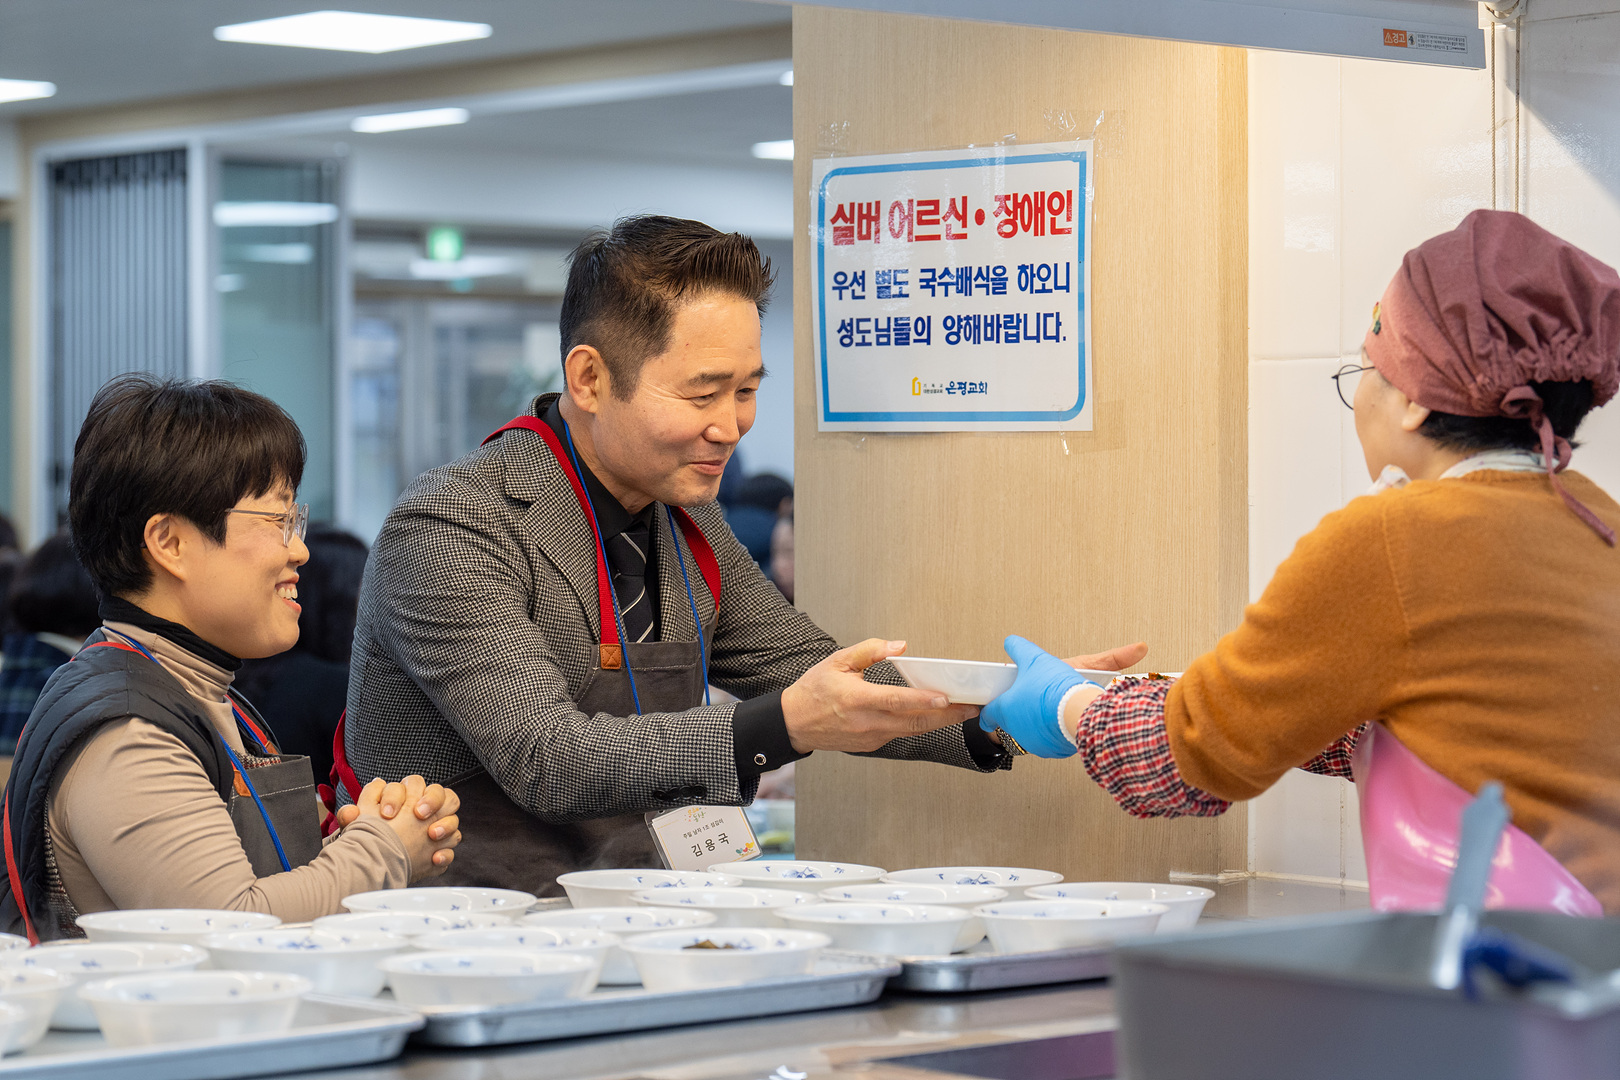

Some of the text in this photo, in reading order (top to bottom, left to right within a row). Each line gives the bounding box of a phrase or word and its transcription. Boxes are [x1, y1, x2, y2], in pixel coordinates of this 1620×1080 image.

[1392, 32, 1405, 43] 경고
[830, 200, 881, 246] 실버
[888, 195, 968, 243] 어르신
[992, 189, 1073, 239] 장애인
[831, 261, 1071, 301] 우선 별도 국수배식을 하오니
[836, 311, 1066, 348] 성도님들의 양해바랍니다.
[945, 380, 988, 396] 은평교회
[691, 832, 730, 857] 김용국
